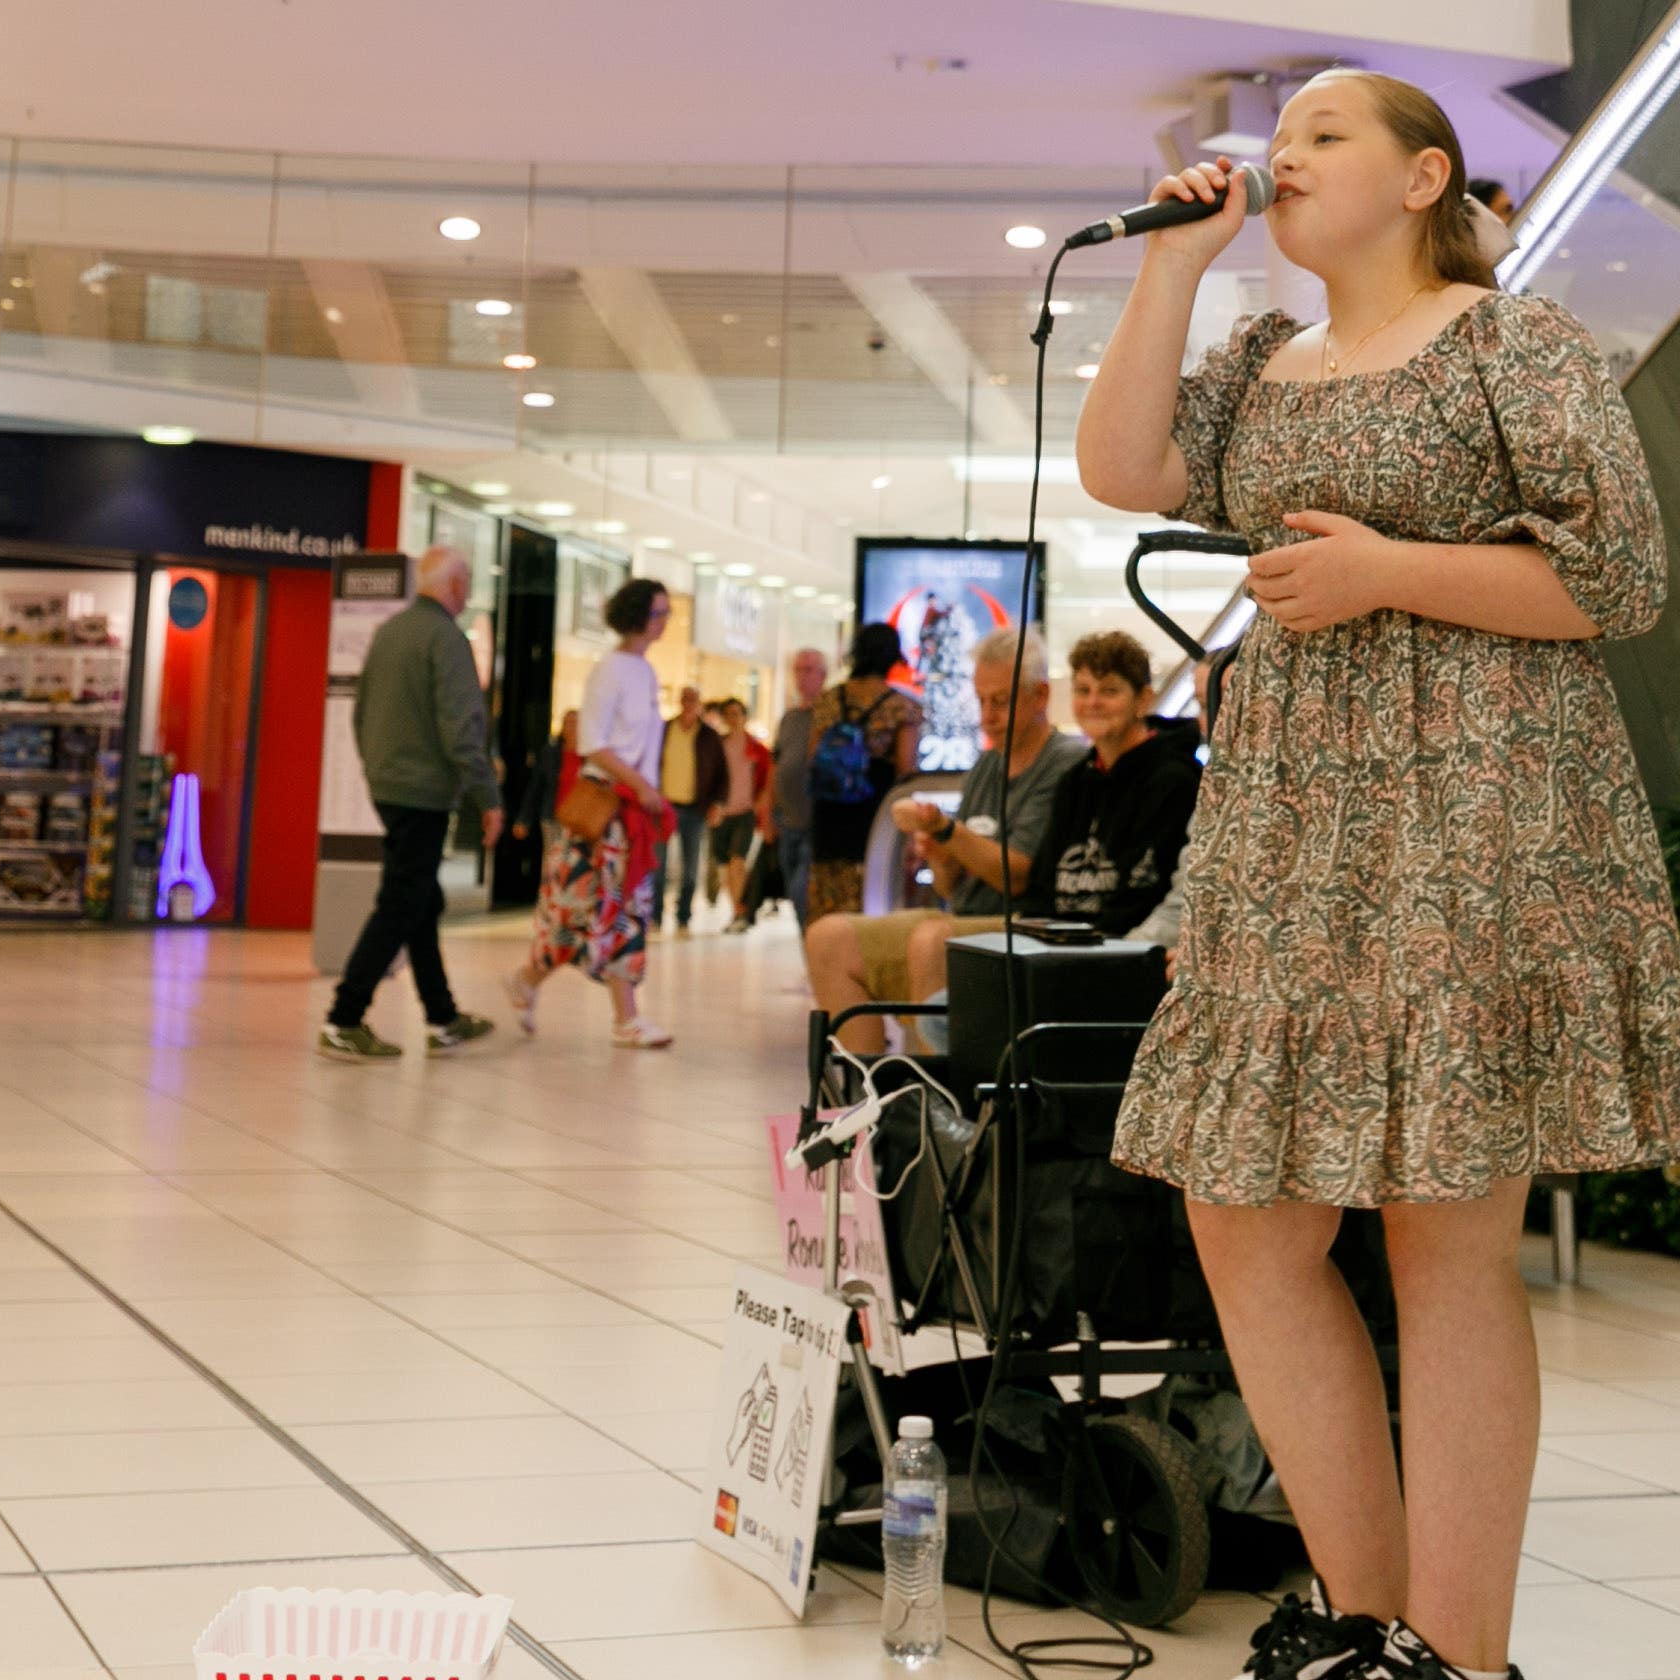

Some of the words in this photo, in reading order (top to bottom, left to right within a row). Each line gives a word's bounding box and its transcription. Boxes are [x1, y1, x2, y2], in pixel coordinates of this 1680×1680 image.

[204, 523, 359, 557] menkind.co.uk
[735, 1289, 778, 1327] Please
[782, 1305, 806, 1345] Tap
